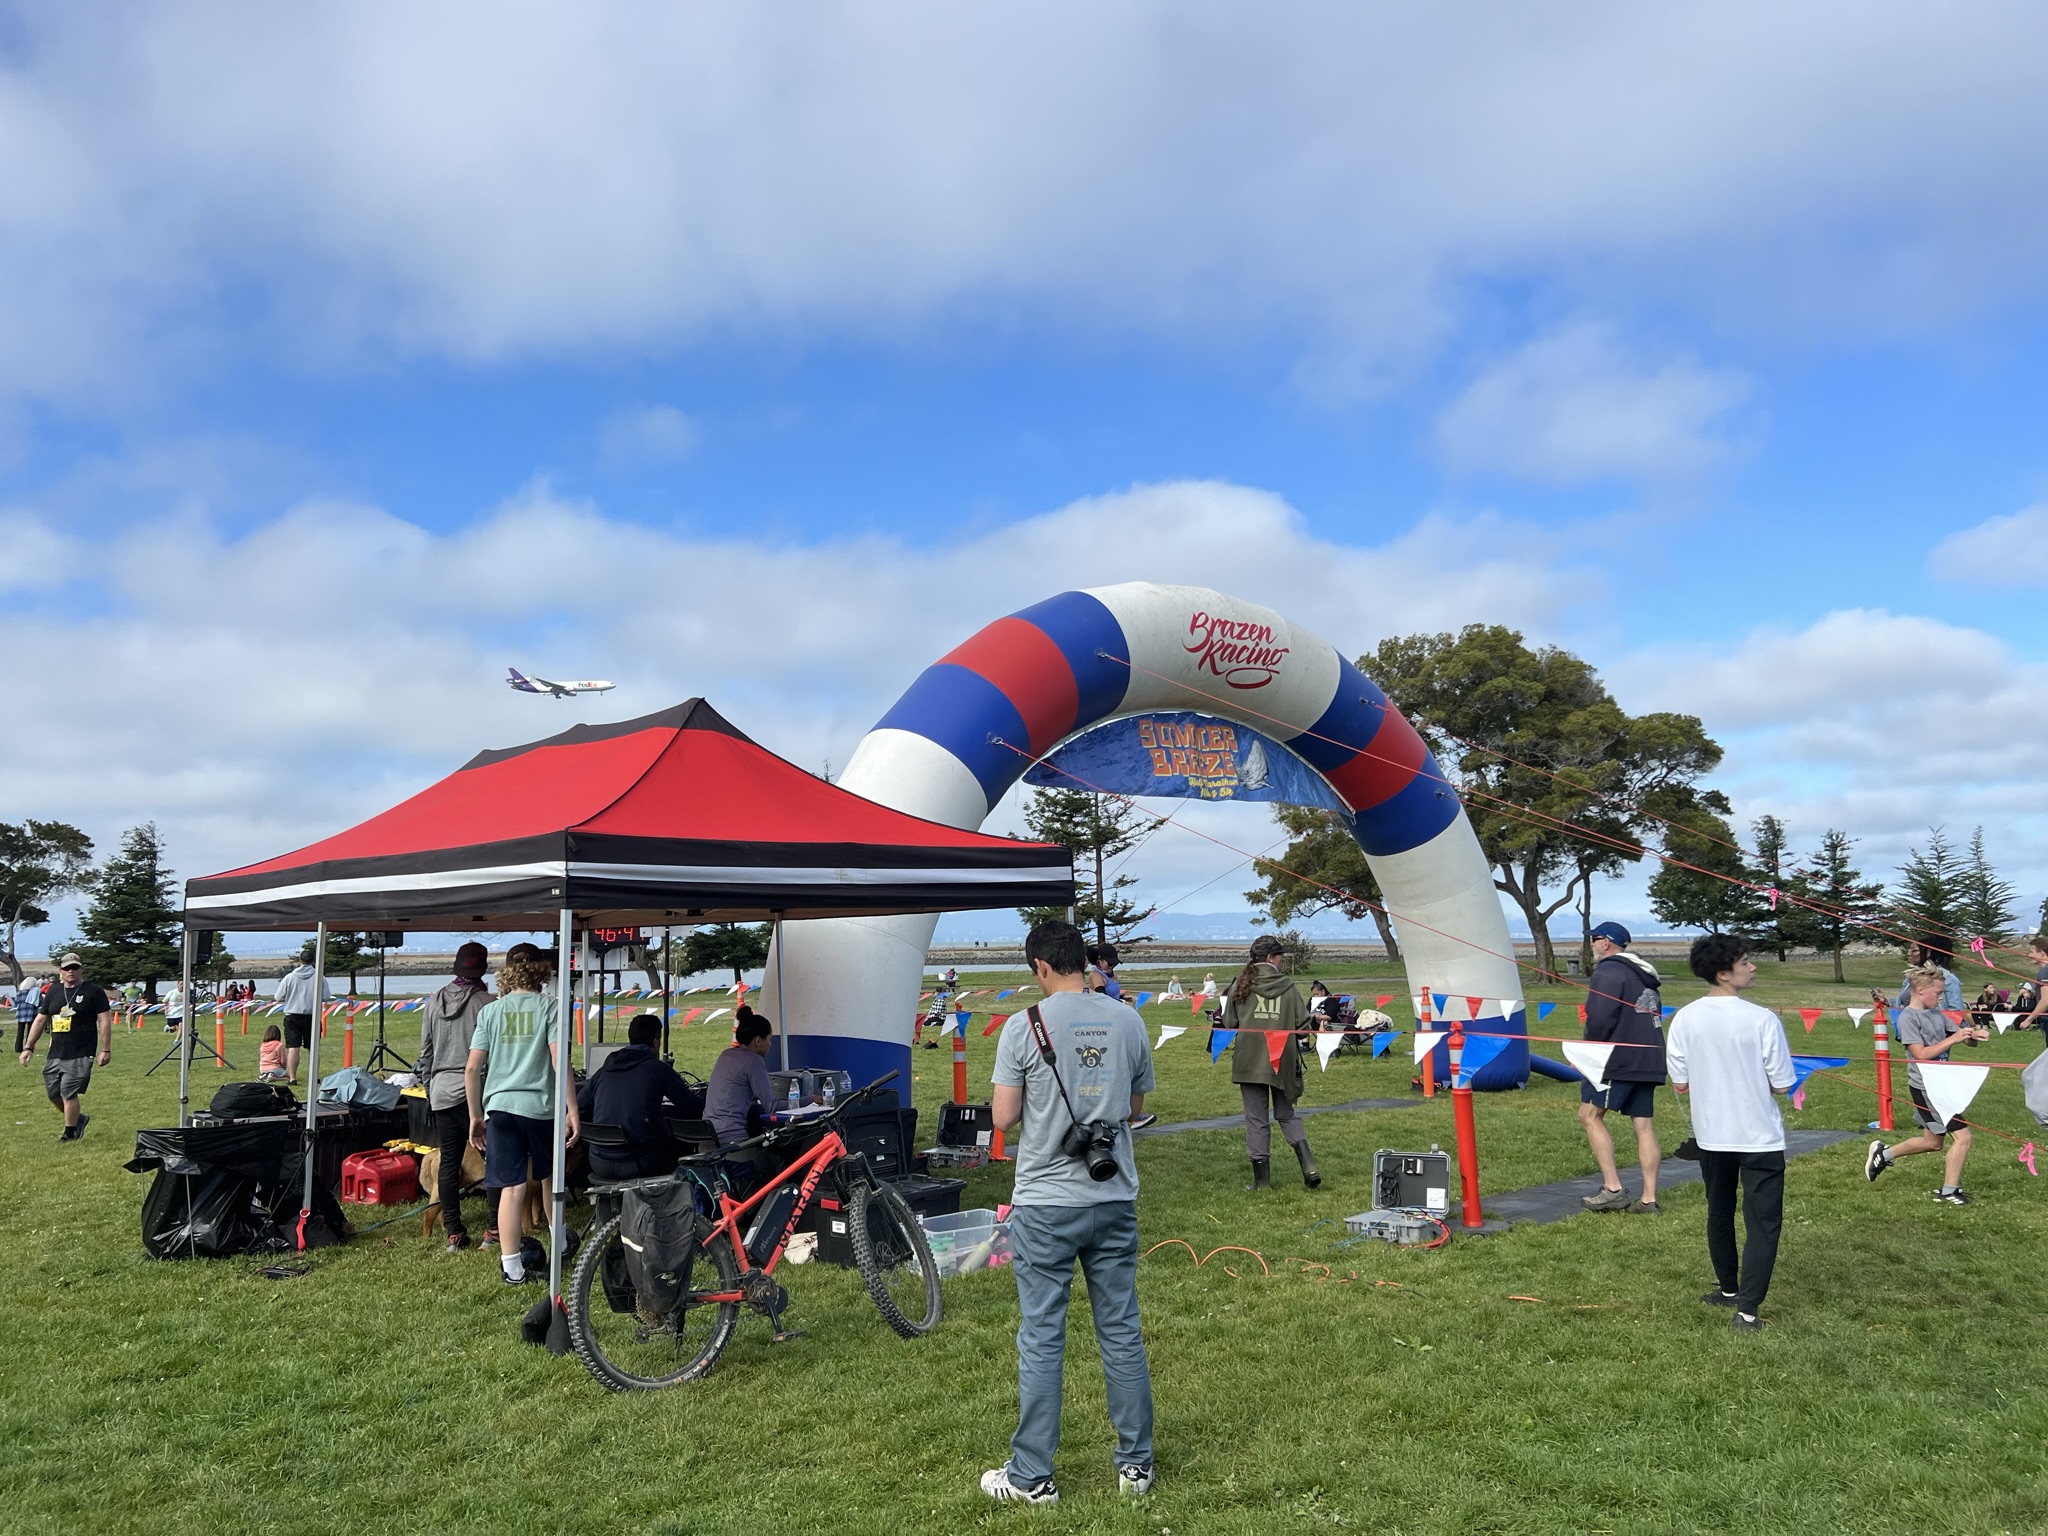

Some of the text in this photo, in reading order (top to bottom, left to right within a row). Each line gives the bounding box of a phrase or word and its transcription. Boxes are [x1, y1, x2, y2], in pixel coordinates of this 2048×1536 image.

[1181, 612, 1278, 652] Brazen
[1198, 638, 1289, 689] Racing
[1150, 748, 1238, 778] BREEZE
[1254, 994, 1281, 1014] XII
[502, 1011, 535, 1036] XII
[1034, 1022, 1047, 1047] Canon
[778, 1169, 822, 1248] MARIN
